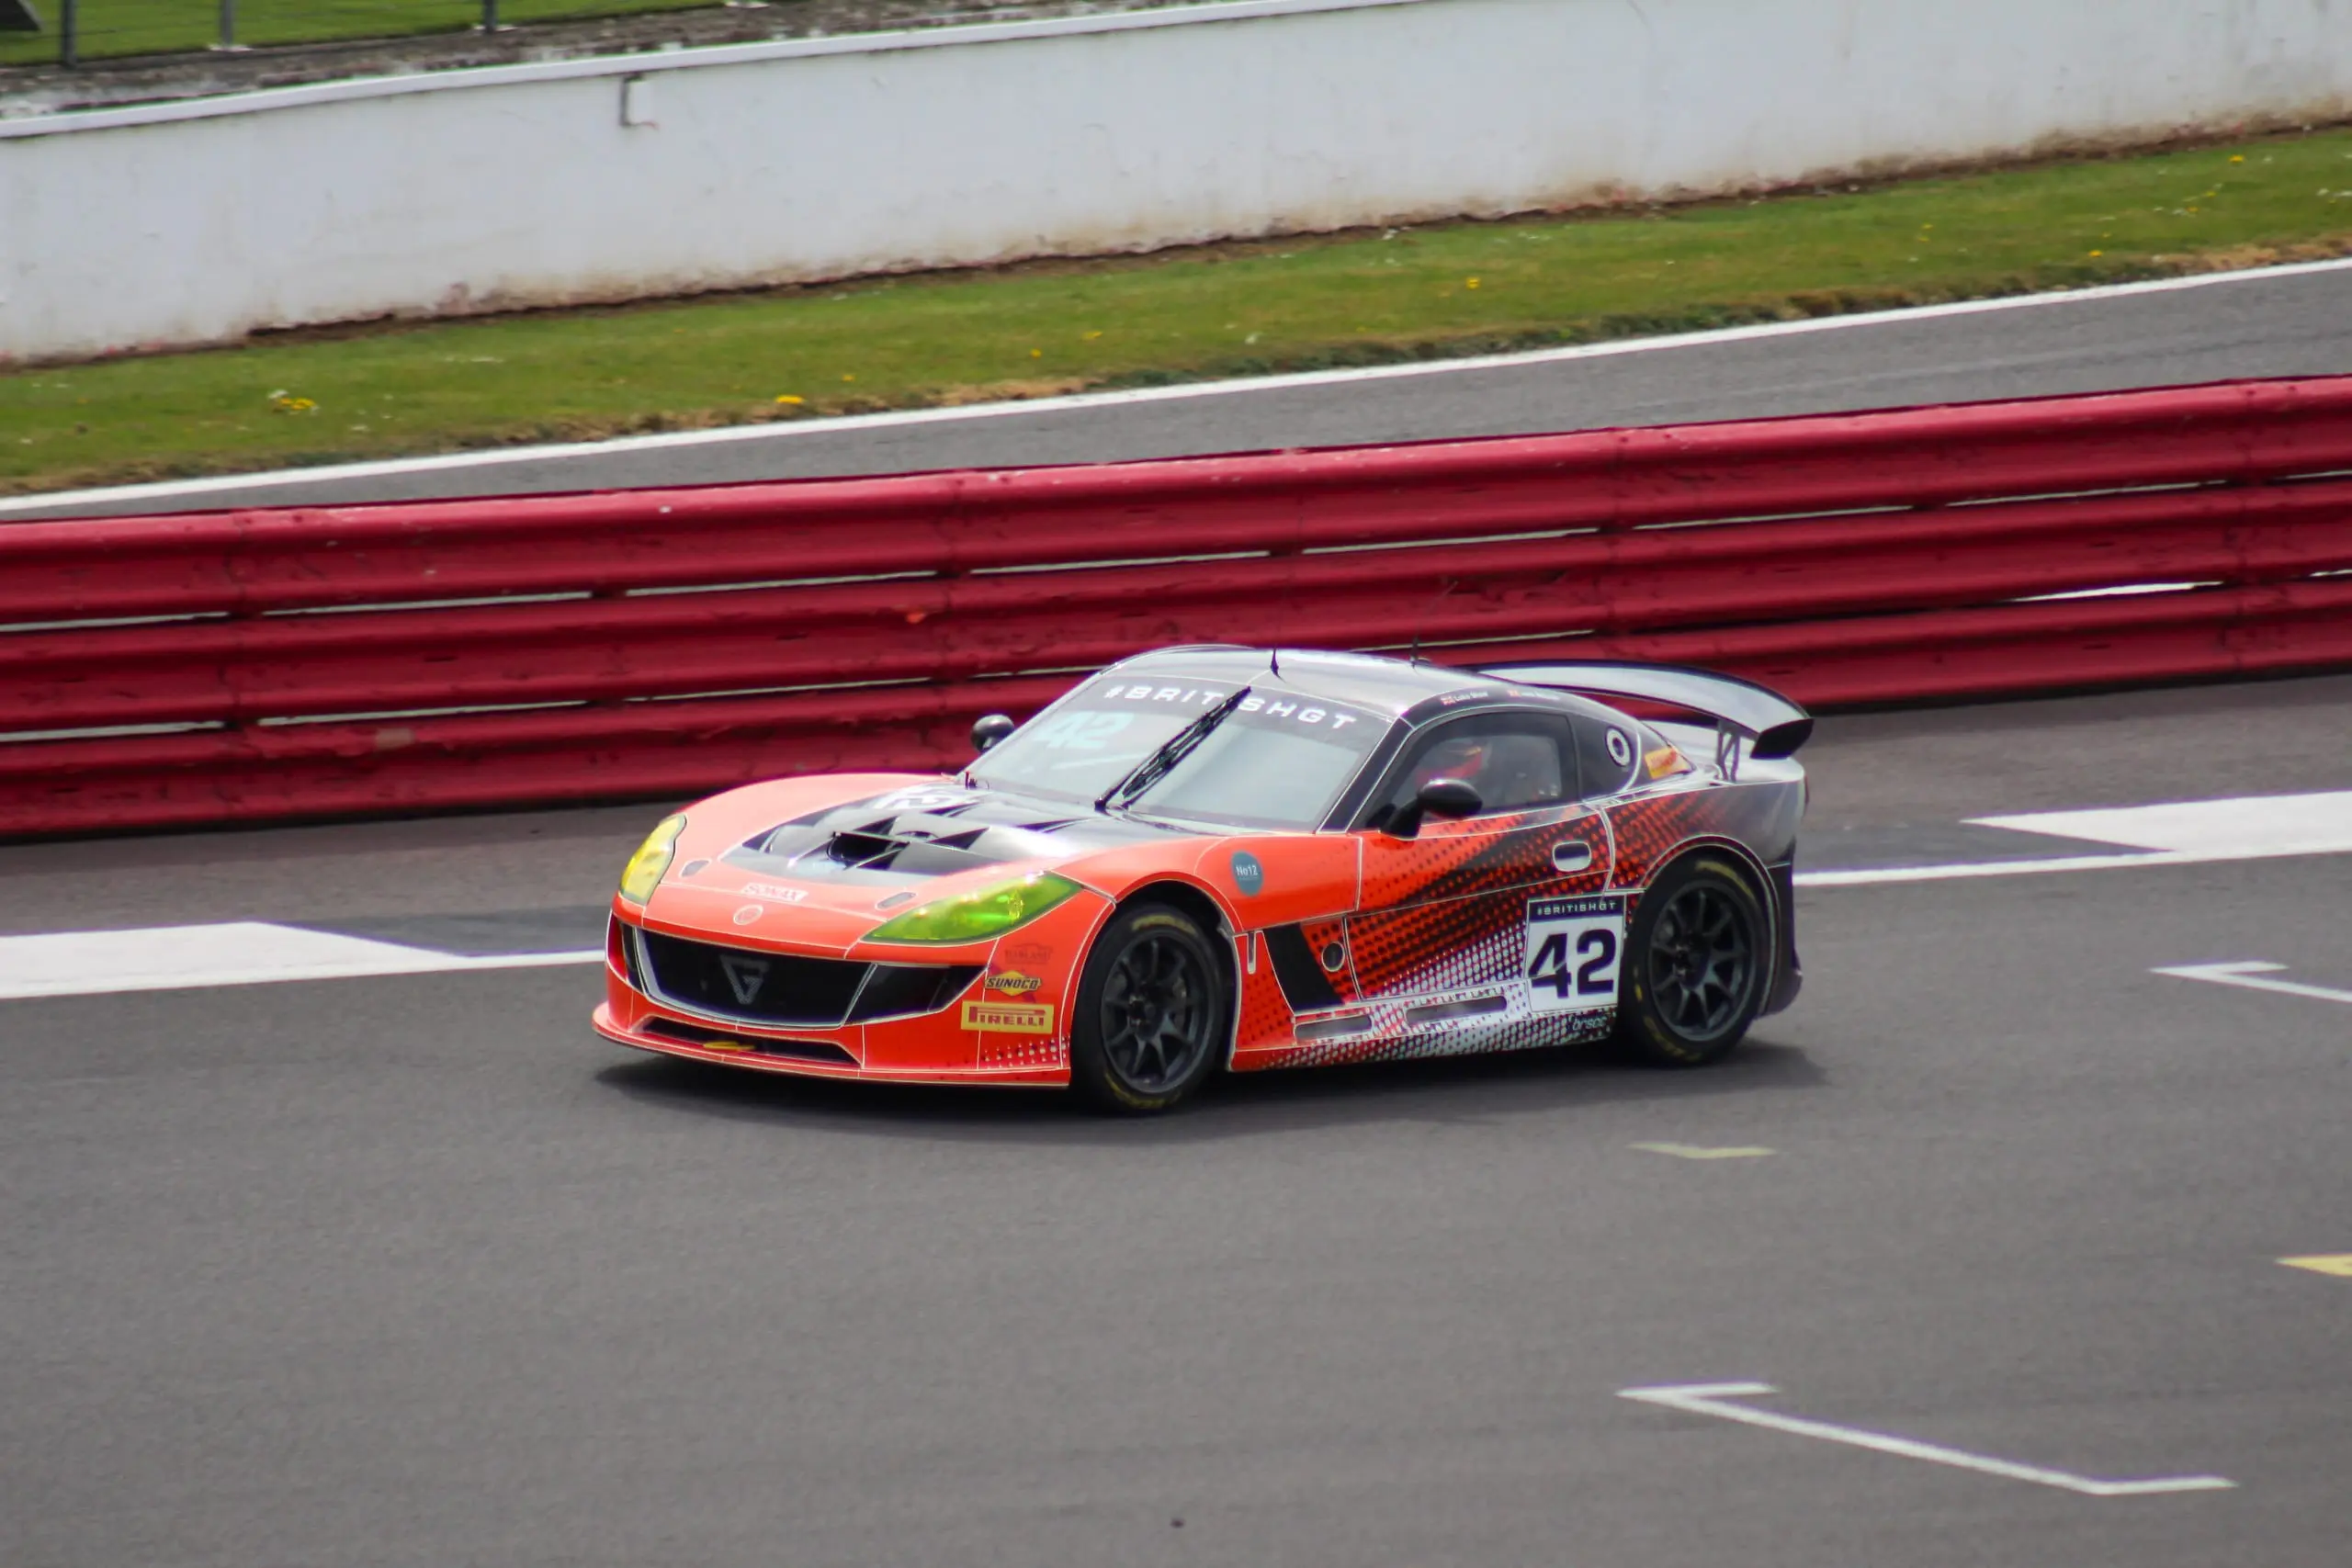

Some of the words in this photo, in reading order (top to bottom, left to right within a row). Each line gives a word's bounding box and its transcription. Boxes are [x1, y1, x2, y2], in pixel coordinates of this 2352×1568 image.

[1103, 685, 1357, 728] #BRITSHGT
[1032, 711, 1134, 748] 42
[1529, 929, 1616, 998] 42
[986, 977, 1039, 990] SUNOCO
[968, 1006, 1046, 1027] PIRELLI
